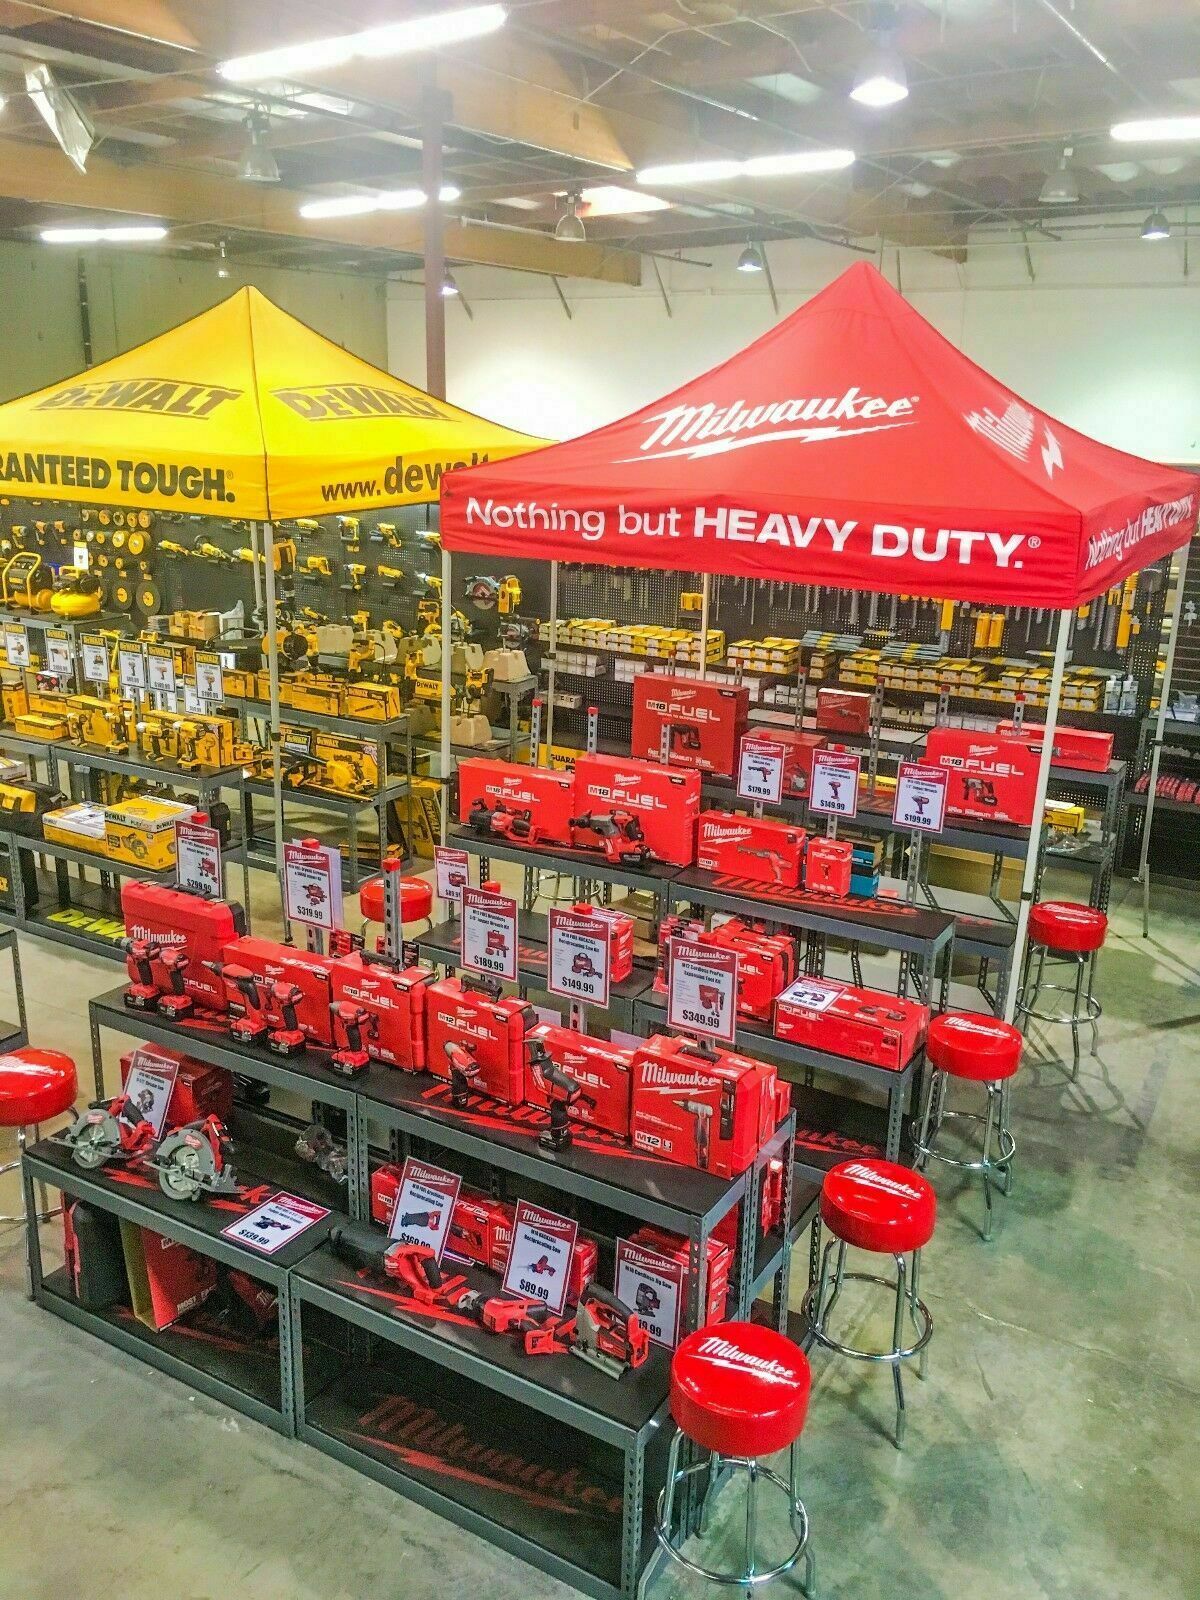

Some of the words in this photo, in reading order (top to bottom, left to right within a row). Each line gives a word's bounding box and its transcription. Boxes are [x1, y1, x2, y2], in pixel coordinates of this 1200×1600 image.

[0, 451, 111, 489] ANTEED
[466, 497, 605, 541] Nothing
[618, 504, 681, 537] but
[693, 507, 859, 553] HEAVY
[669, 704, 721, 721] FUEL
[966, 759, 1024, 776] FUEL
[502, 788, 541, 802] FUEL
[589, 786, 609, 795] M18
[612, 789, 668, 808] FUEL
[748, 785, 771, 796] $179.99
[820, 800, 846, 811] $149.99
[904, 813, 932, 826] $199.99
[702, 823, 752, 838] Milwaukee
[288, 850, 327, 861] Milwaukee
[187, 878, 212, 893] $299.99
[466, 892, 513, 907] Milwaukee
[297, 906, 323, 920] $319.99
[553, 915, 605, 928] Milwaukee
[131, 925, 188, 944] Milwaukee
[675, 945, 732, 960] Milwaukee
[474, 955, 504, 972] $189.99
[188, 980, 218, 994] FUEL
[561, 976, 594, 994] $149.99
[360, 990, 399, 1010] FUEL
[682, 1009, 720, 1028] $349.99
[455, 1018, 499, 1040] FUEL
[137, 1056, 174, 1070] Milwaukee
[562, 1066, 611, 1089] FUEL
[637, 1060, 721, 1087] Milwaukee
[636, 1132, 660, 1146] M12
[410, 1166, 455, 1184] Milwaukee
[844, 1163, 922, 1199] Milwaukee
[521, 1208, 572, 1229] Milwaukee
[238, 1229, 270, 1245] $139.99
[622, 1247, 677, 1270] Milwaukee
[519, 1278, 549, 1300] $89.99
[697, 1336, 797, 1379] Milwaukee
